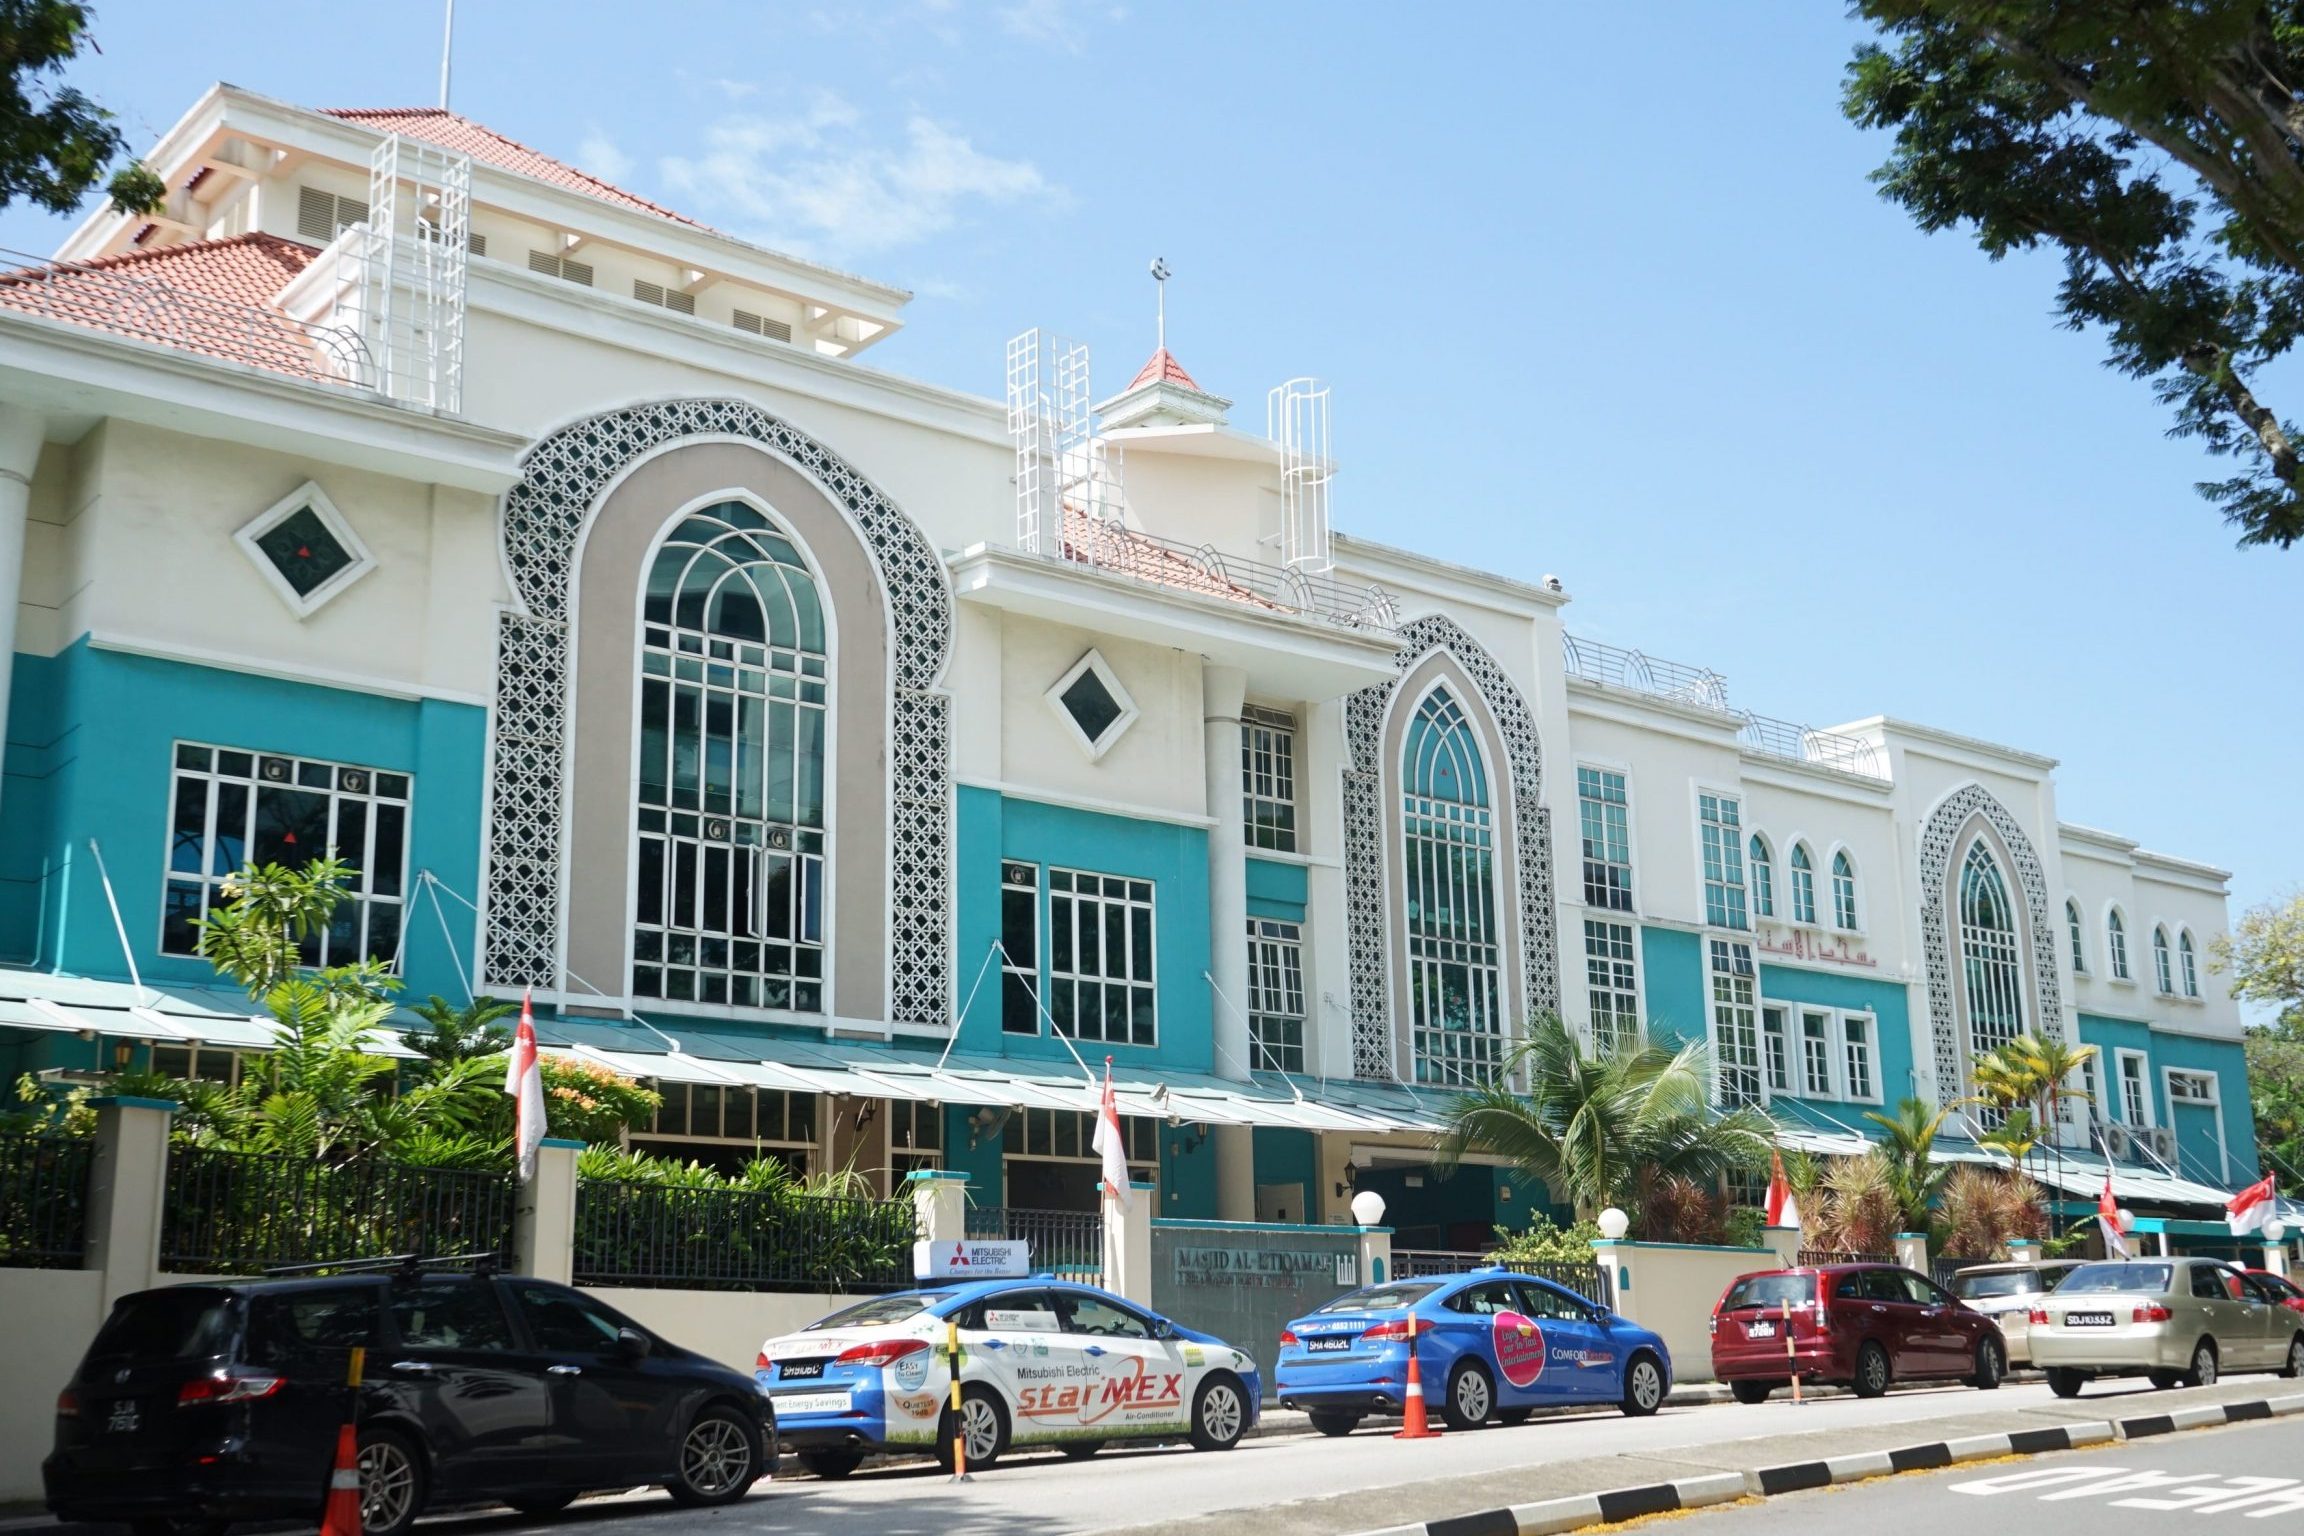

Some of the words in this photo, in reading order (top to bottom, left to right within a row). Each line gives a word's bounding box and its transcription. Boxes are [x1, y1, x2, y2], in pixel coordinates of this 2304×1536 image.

[971, 1247, 1012, 1257] MITSUBISHI
[971, 1256, 1007, 1266] ELECTRIC
[899, 1361, 919, 1371] EASY
[1017, 1366, 1065, 1380] Mitsubishi
[1066, 1364, 1100, 1377] Electric
[788, 1399, 813, 1410] Energy
[815, 1397, 848, 1409] Savings
[1125, 1410, 1175, 1421] Air-Conditioner
